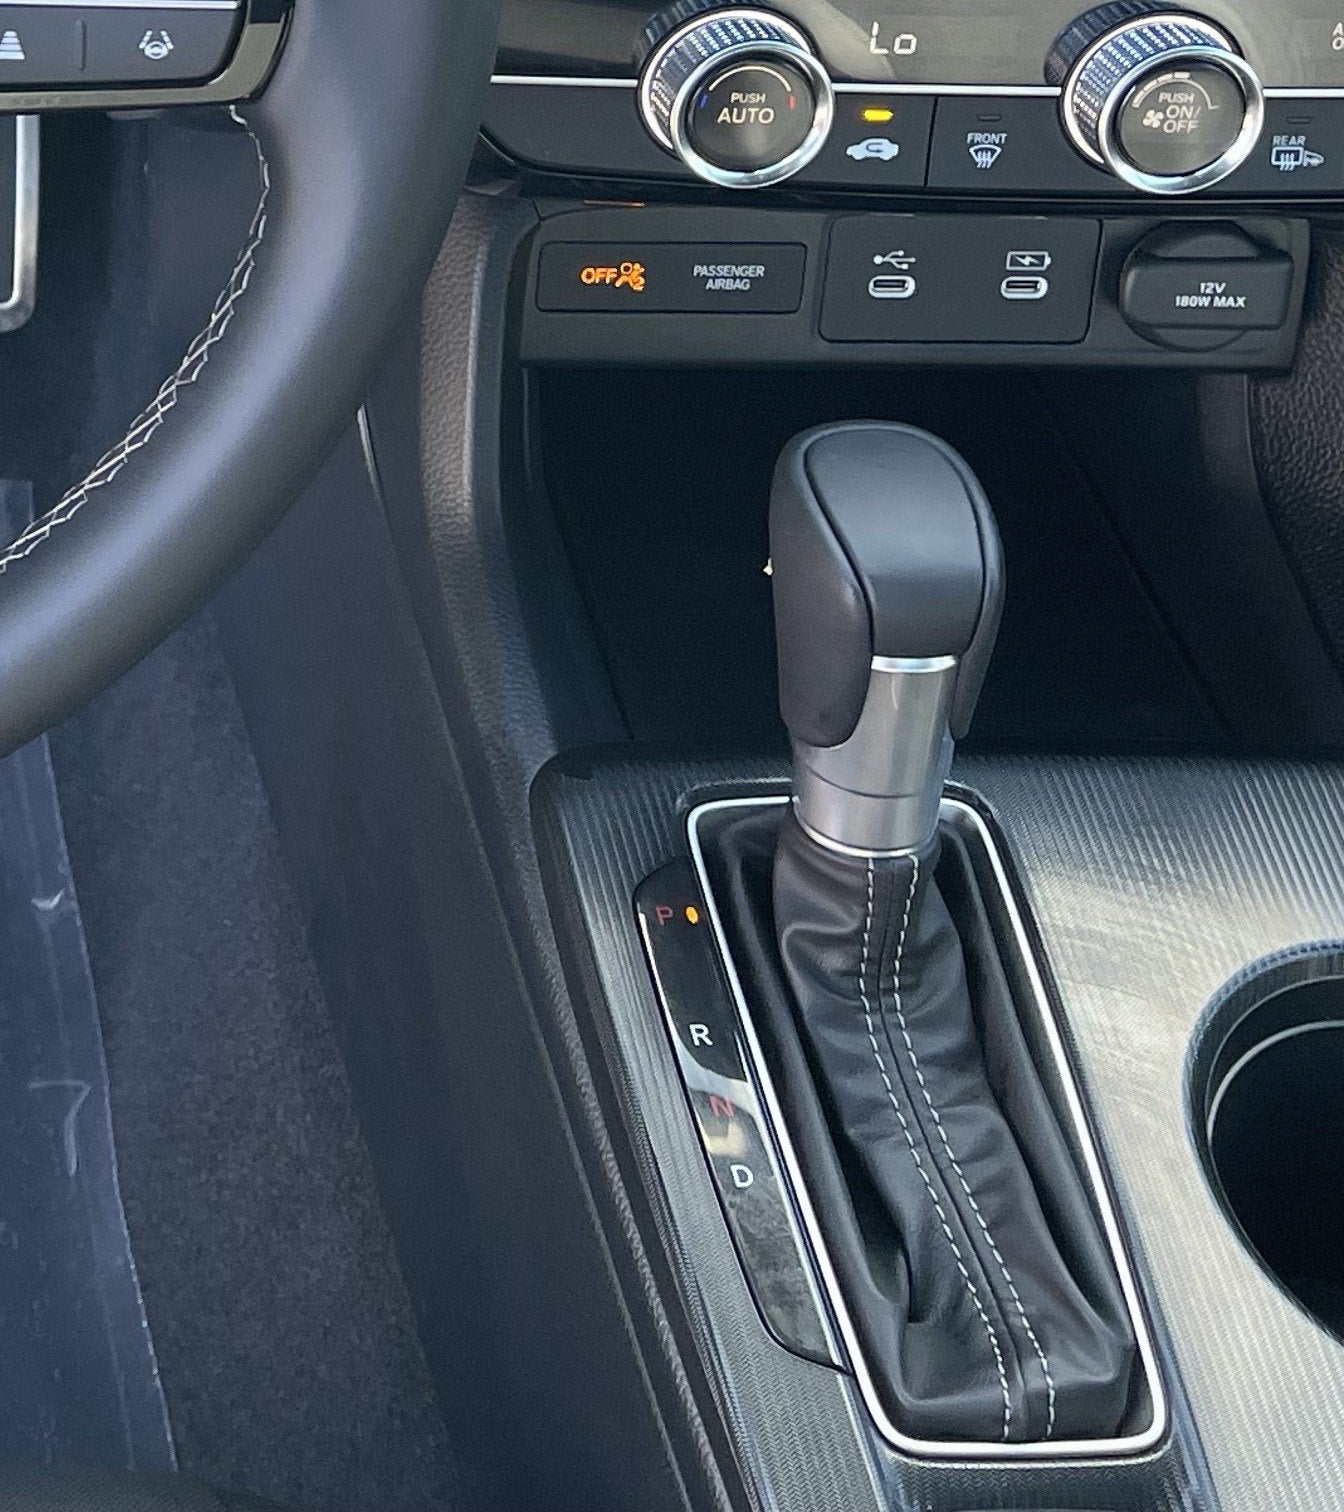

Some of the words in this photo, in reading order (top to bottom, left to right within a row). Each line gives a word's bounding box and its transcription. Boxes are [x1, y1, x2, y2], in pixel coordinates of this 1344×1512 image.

[729, 92, 767, 104] PUSH
[1157, 91, 1195, 104] PUSH
[716, 106, 775, 125] AUTO
[1166, 104, 1202, 120] ON/
[1163, 119, 1200, 134] OFF
[966, 131, 1009, 147] FRONT
[1272, 135, 1307, 147] REAR
[580, 266, 618, 285] OFF
[692, 263, 766, 278] PASSENGER
[705, 277, 751, 291] AIRBAG
[1199, 281, 1227, 294] 12V
[1174, 294, 1212, 308] 180W
[1212, 295, 1247, 308] MAX
[654, 905, 674, 926] P
[688, 1023, 713, 1046] R
[730, 1164, 755, 1188] D
